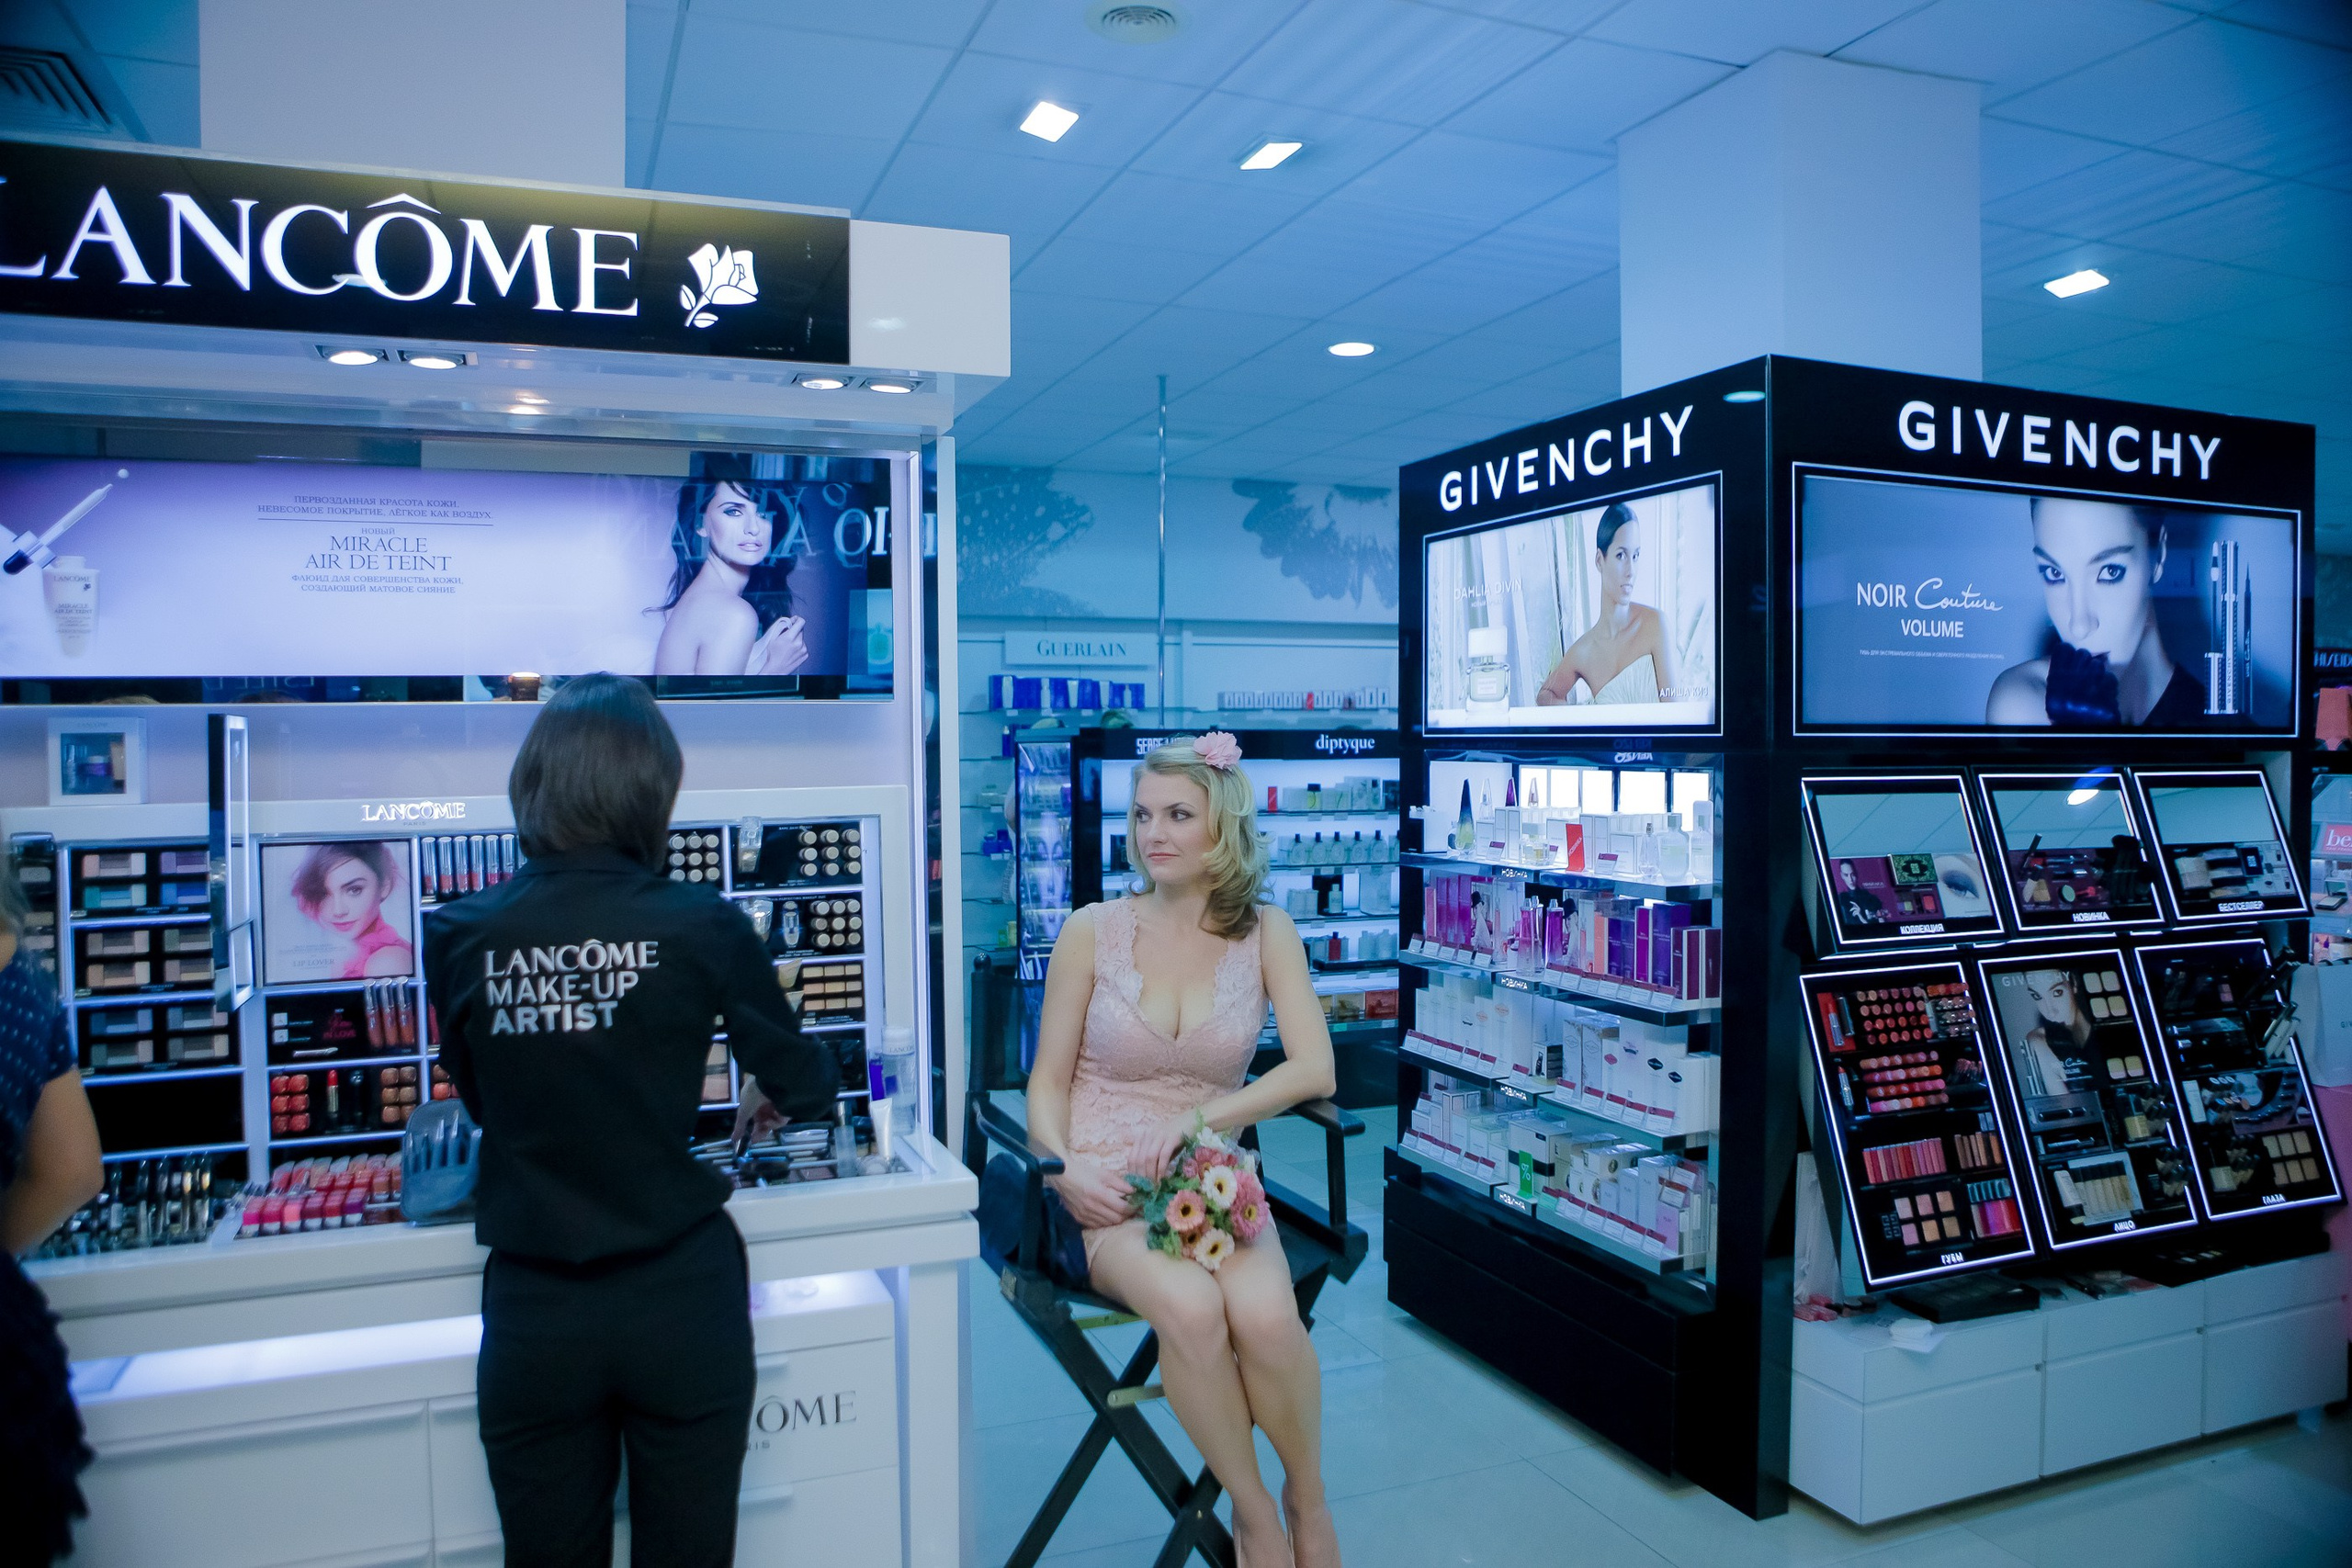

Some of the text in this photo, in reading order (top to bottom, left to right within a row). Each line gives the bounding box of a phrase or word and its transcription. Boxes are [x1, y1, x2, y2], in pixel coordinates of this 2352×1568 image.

[1898, 400, 2222, 480] GIVENCHY
[1440, 405, 1693, 512] GIVENCHY
[294, 495, 376, 505] ПЕРВОЗДАННАЯ
[379, 498, 424, 507] КРАСОТА
[257, 504, 322, 514] НЕВЕСОМОЕ
[430, 510, 449, 518] КАК
[330, 536, 428, 553] MIRACLE
[305, 553, 452, 571] AIR DE TEINT
[291, 574, 329, 583] ФЛЮИД
[331, 575, 351, 583] ДЛЯ
[353, 575, 431, 584] СОВЕРШЕНСТВА
[301, 583, 456, 594] СОЗДАЮЩИЙ МАТОВОЕ СИЯНИЕ
[1857, 577, 2004, 611] NOIR Couture
[1901, 618, 1964, 637] VOLUME
[1036, 639, 1127, 657] GUERLAIN
[1315, 733, 1376, 754] diptyque
[361, 799, 466, 821] LANCÔME
[2218, 900, 2266, 913] БЕСТСЕЛЛЕР
[2072, 911, 2111, 922] НОВИНКА
[1900, 922, 1945, 934] КОЛЛЕКЦИЯ
[484, 938, 661, 979] LANCÔME
[485, 970, 639, 1008] MAKE-UP
[491, 1000, 619, 1036] ARTIST
[2262, 1193, 2286, 1205] ГЛАЗА
[2114, 1220, 2137, 1232] ЛИЦО
[1940, 1252, 1964, 1266] ГУБЫ
